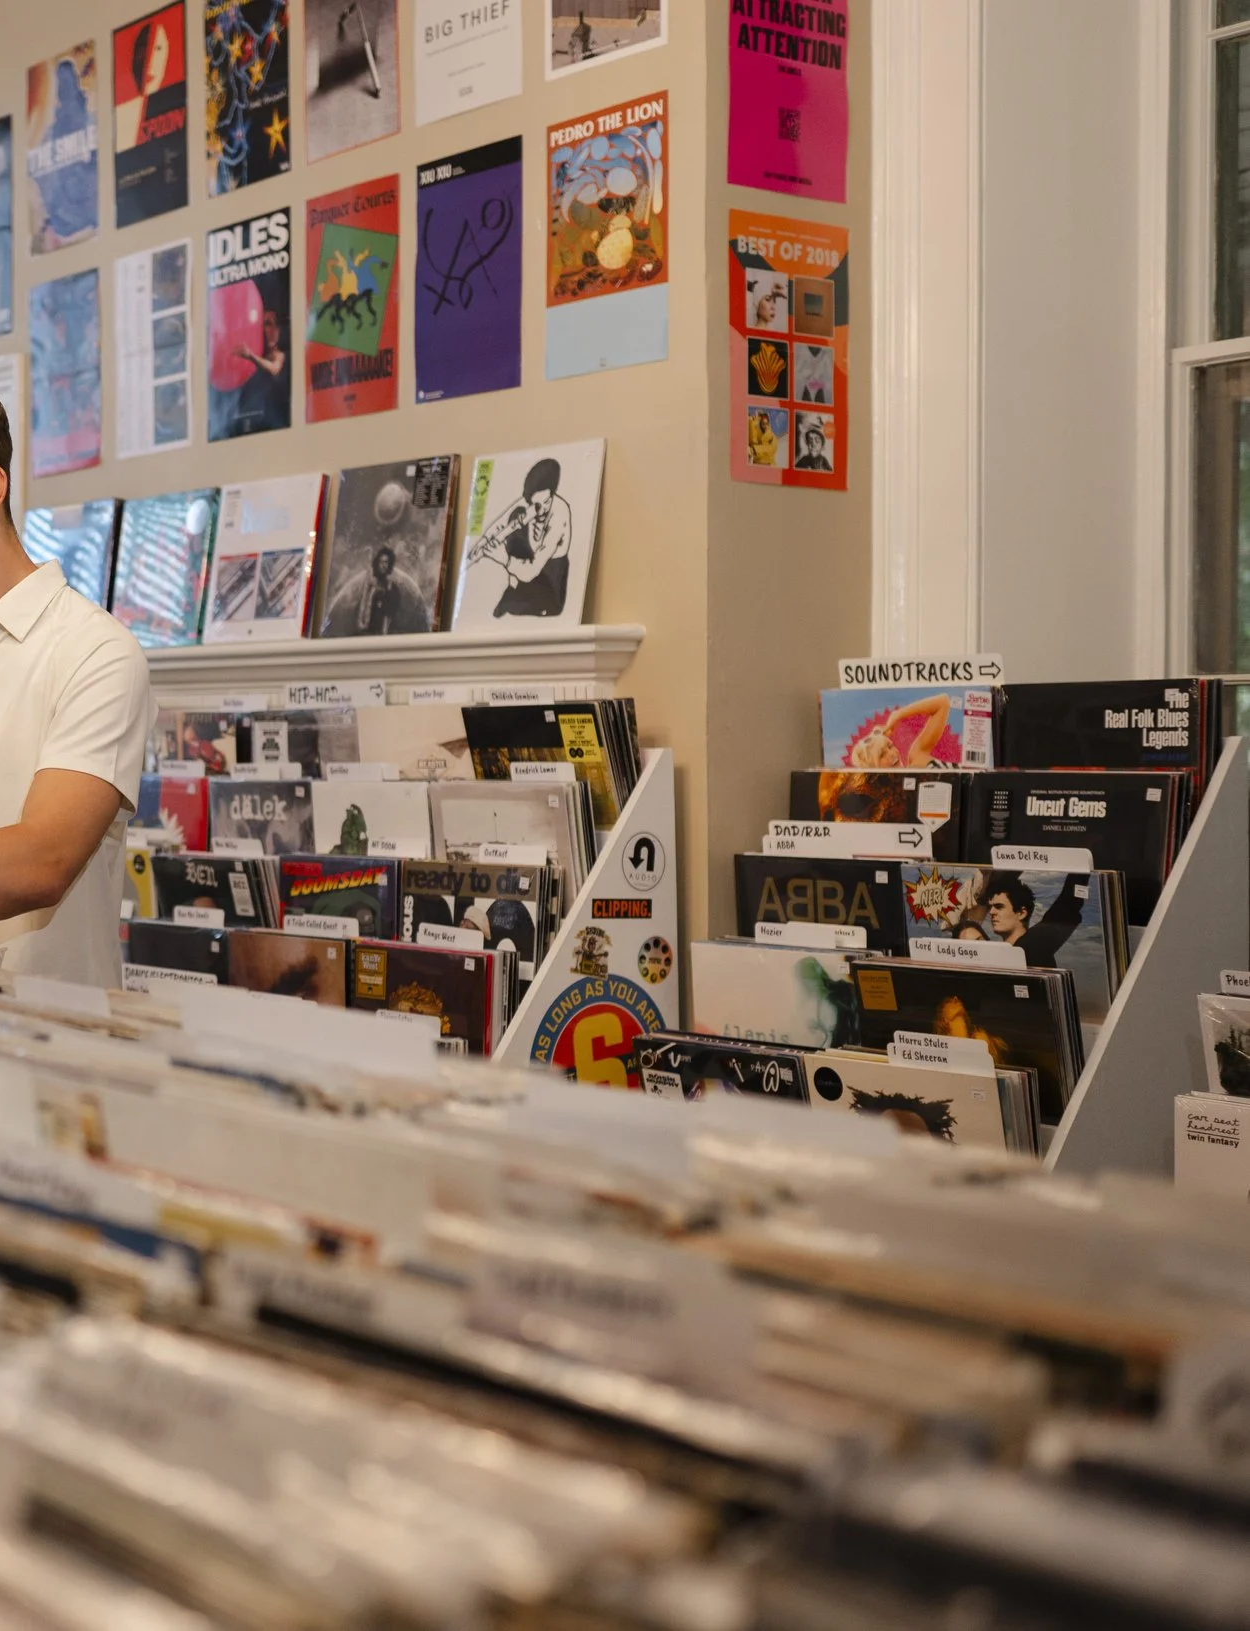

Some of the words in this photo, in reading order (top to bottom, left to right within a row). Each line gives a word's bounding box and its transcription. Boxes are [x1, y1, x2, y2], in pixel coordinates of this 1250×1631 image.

[425, 19, 453, 43] BIG
[460, 0, 510, 30] THIEF
[732, 0, 846, 38] ATTRACTING
[737, 23, 842, 70] ATTENTION
[550, 120, 595, 148] PEDRO
[597, 111, 624, 133] THE
[626, 98, 664, 124] LION
[209, 212, 290, 268] IDLES
[737, 233, 777, 258] BEST
[780, 241, 802, 262] OF
[209, 263, 248, 288] ULTRA
[249, 251, 290, 275] MONO
[844, 661, 974, 684] SOUNDTRACKS
[1104, 709, 1128, 729] Real
[1132, 708, 1155, 728] Folk
[1157, 708, 1190, 728] Blues
[1142, 728, 1189, 750] Legends
[1026, 796, 1065, 817] Uncut
[1068, 797, 1107, 817] Gems
[776, 841, 796, 849] ABBA
[996, 851, 1017, 860] Lana
[1018, 851, 1032, 861] Del
[1033, 852, 1049, 863] Rey
[406, 864, 465, 896] ready
[469, 867, 491, 893] to
[629, 873, 657, 883] AUDIO
[593, 900, 652, 917] CLIPPING.
[755, 876, 880, 929] ABBA
[441, 931, 456, 943] West
[760, 926, 783, 936] Hozier
[937, 945, 956, 957] Lady
[957, 946, 979, 959] Gaga
[535, 1034, 551, 1063] AS
[546, 988, 582, 1033] LONG
[584, 980, 604, 999] AS
[608, 979, 638, 1004] YOU
[636, 999, 662, 1033] ARE
[902, 1050, 913, 1061] Ed
[914, 1051, 948, 1063] Sheeran
[1186, 1120, 1240, 1136] headrest
[1214, 1115, 1240, 1127] seat
[1187, 1133, 1205, 1143] twin
[1207, 1135, 1240, 1149] fantasy
